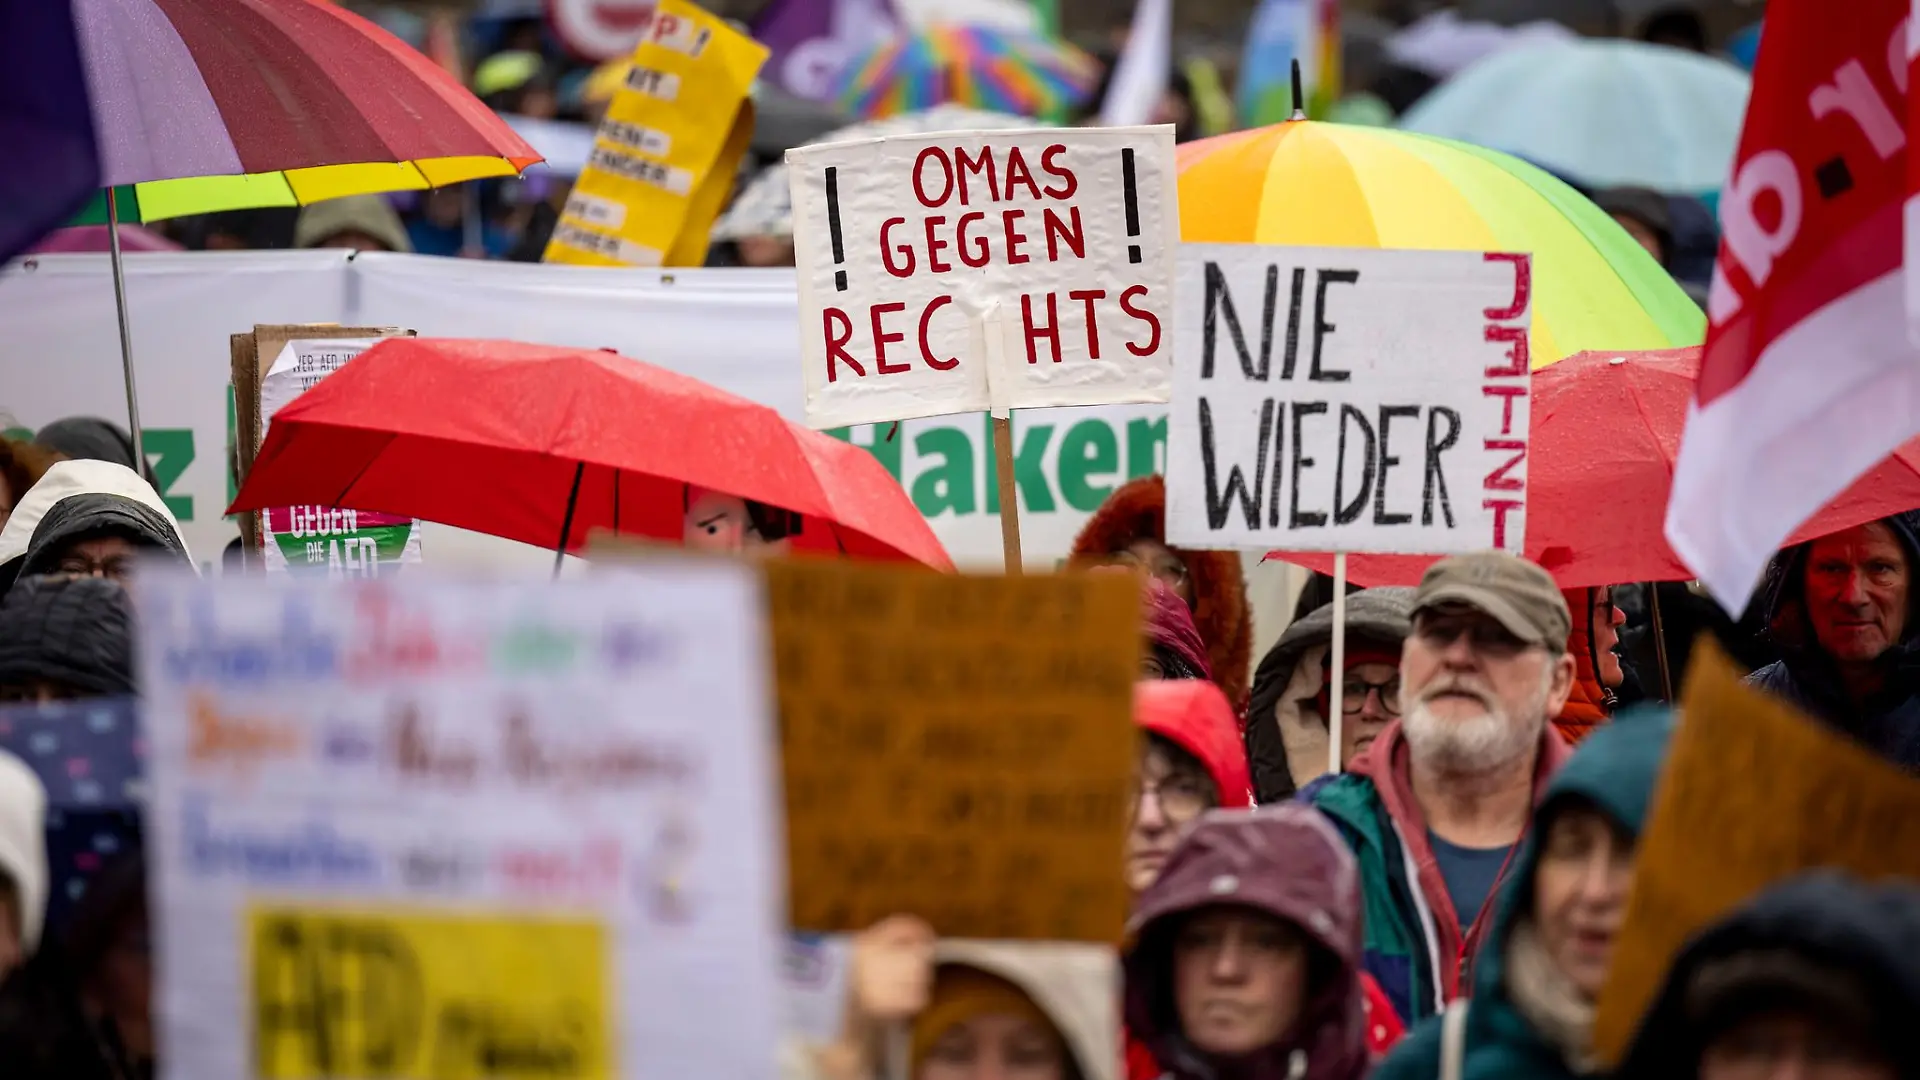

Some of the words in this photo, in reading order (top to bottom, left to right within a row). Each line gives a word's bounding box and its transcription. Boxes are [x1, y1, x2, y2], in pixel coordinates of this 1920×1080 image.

[912, 144, 1079, 208] OMAS
[879, 205, 1086, 278] GEGEN
[1200, 261, 1360, 382] NIE
[1197, 397, 1463, 531] WIEDER
[306, 541, 325, 563] DIE
